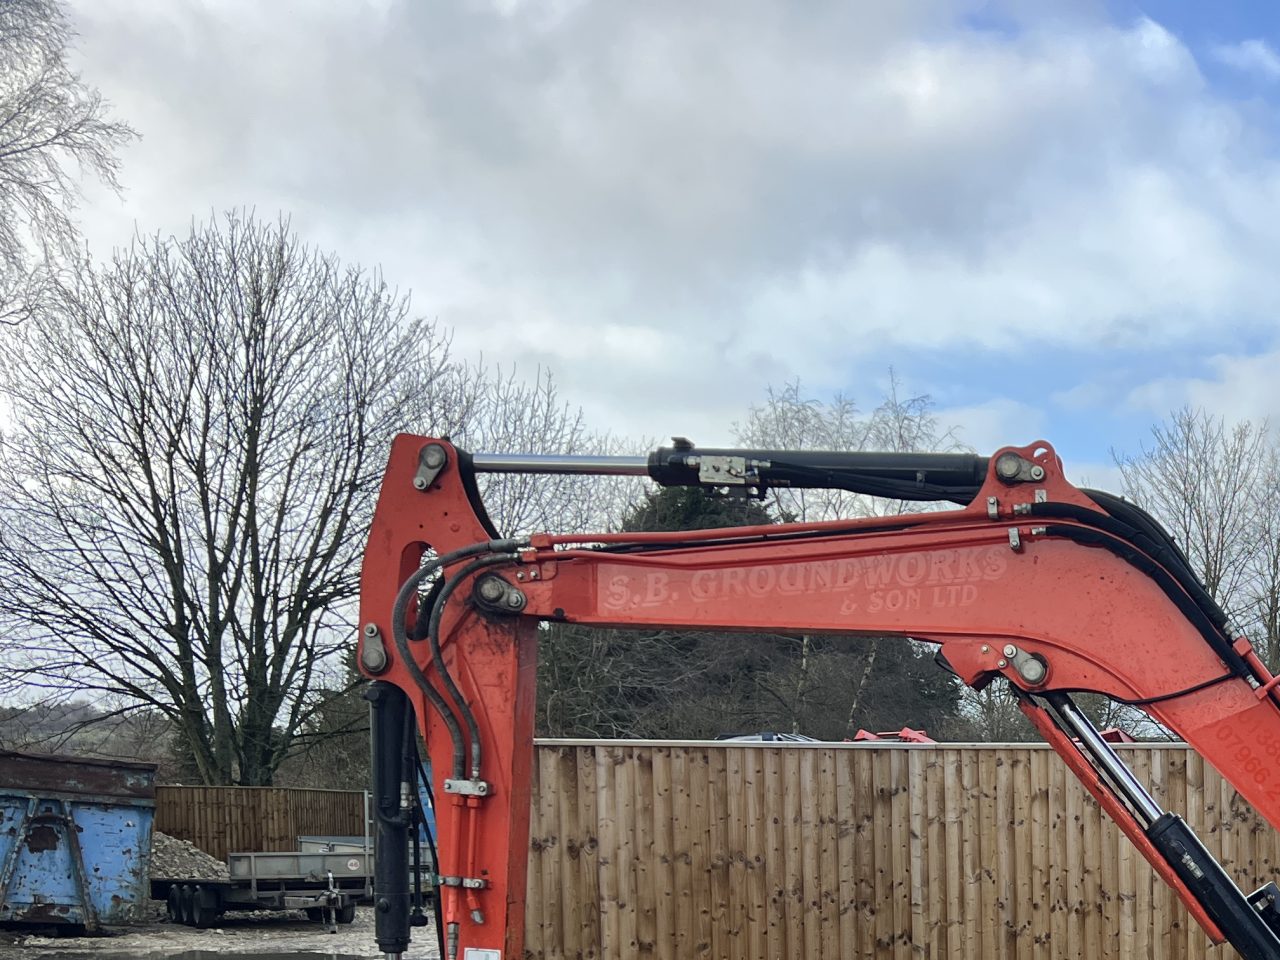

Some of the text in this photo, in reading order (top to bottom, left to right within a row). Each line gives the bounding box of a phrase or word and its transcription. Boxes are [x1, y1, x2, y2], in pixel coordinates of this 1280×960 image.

[688, 549, 1007, 602] GROUNDWORKS
[867, 588, 922, 613] SON
[932, 585, 978, 608] LTD
[1217, 724, 1269, 784] 07966
